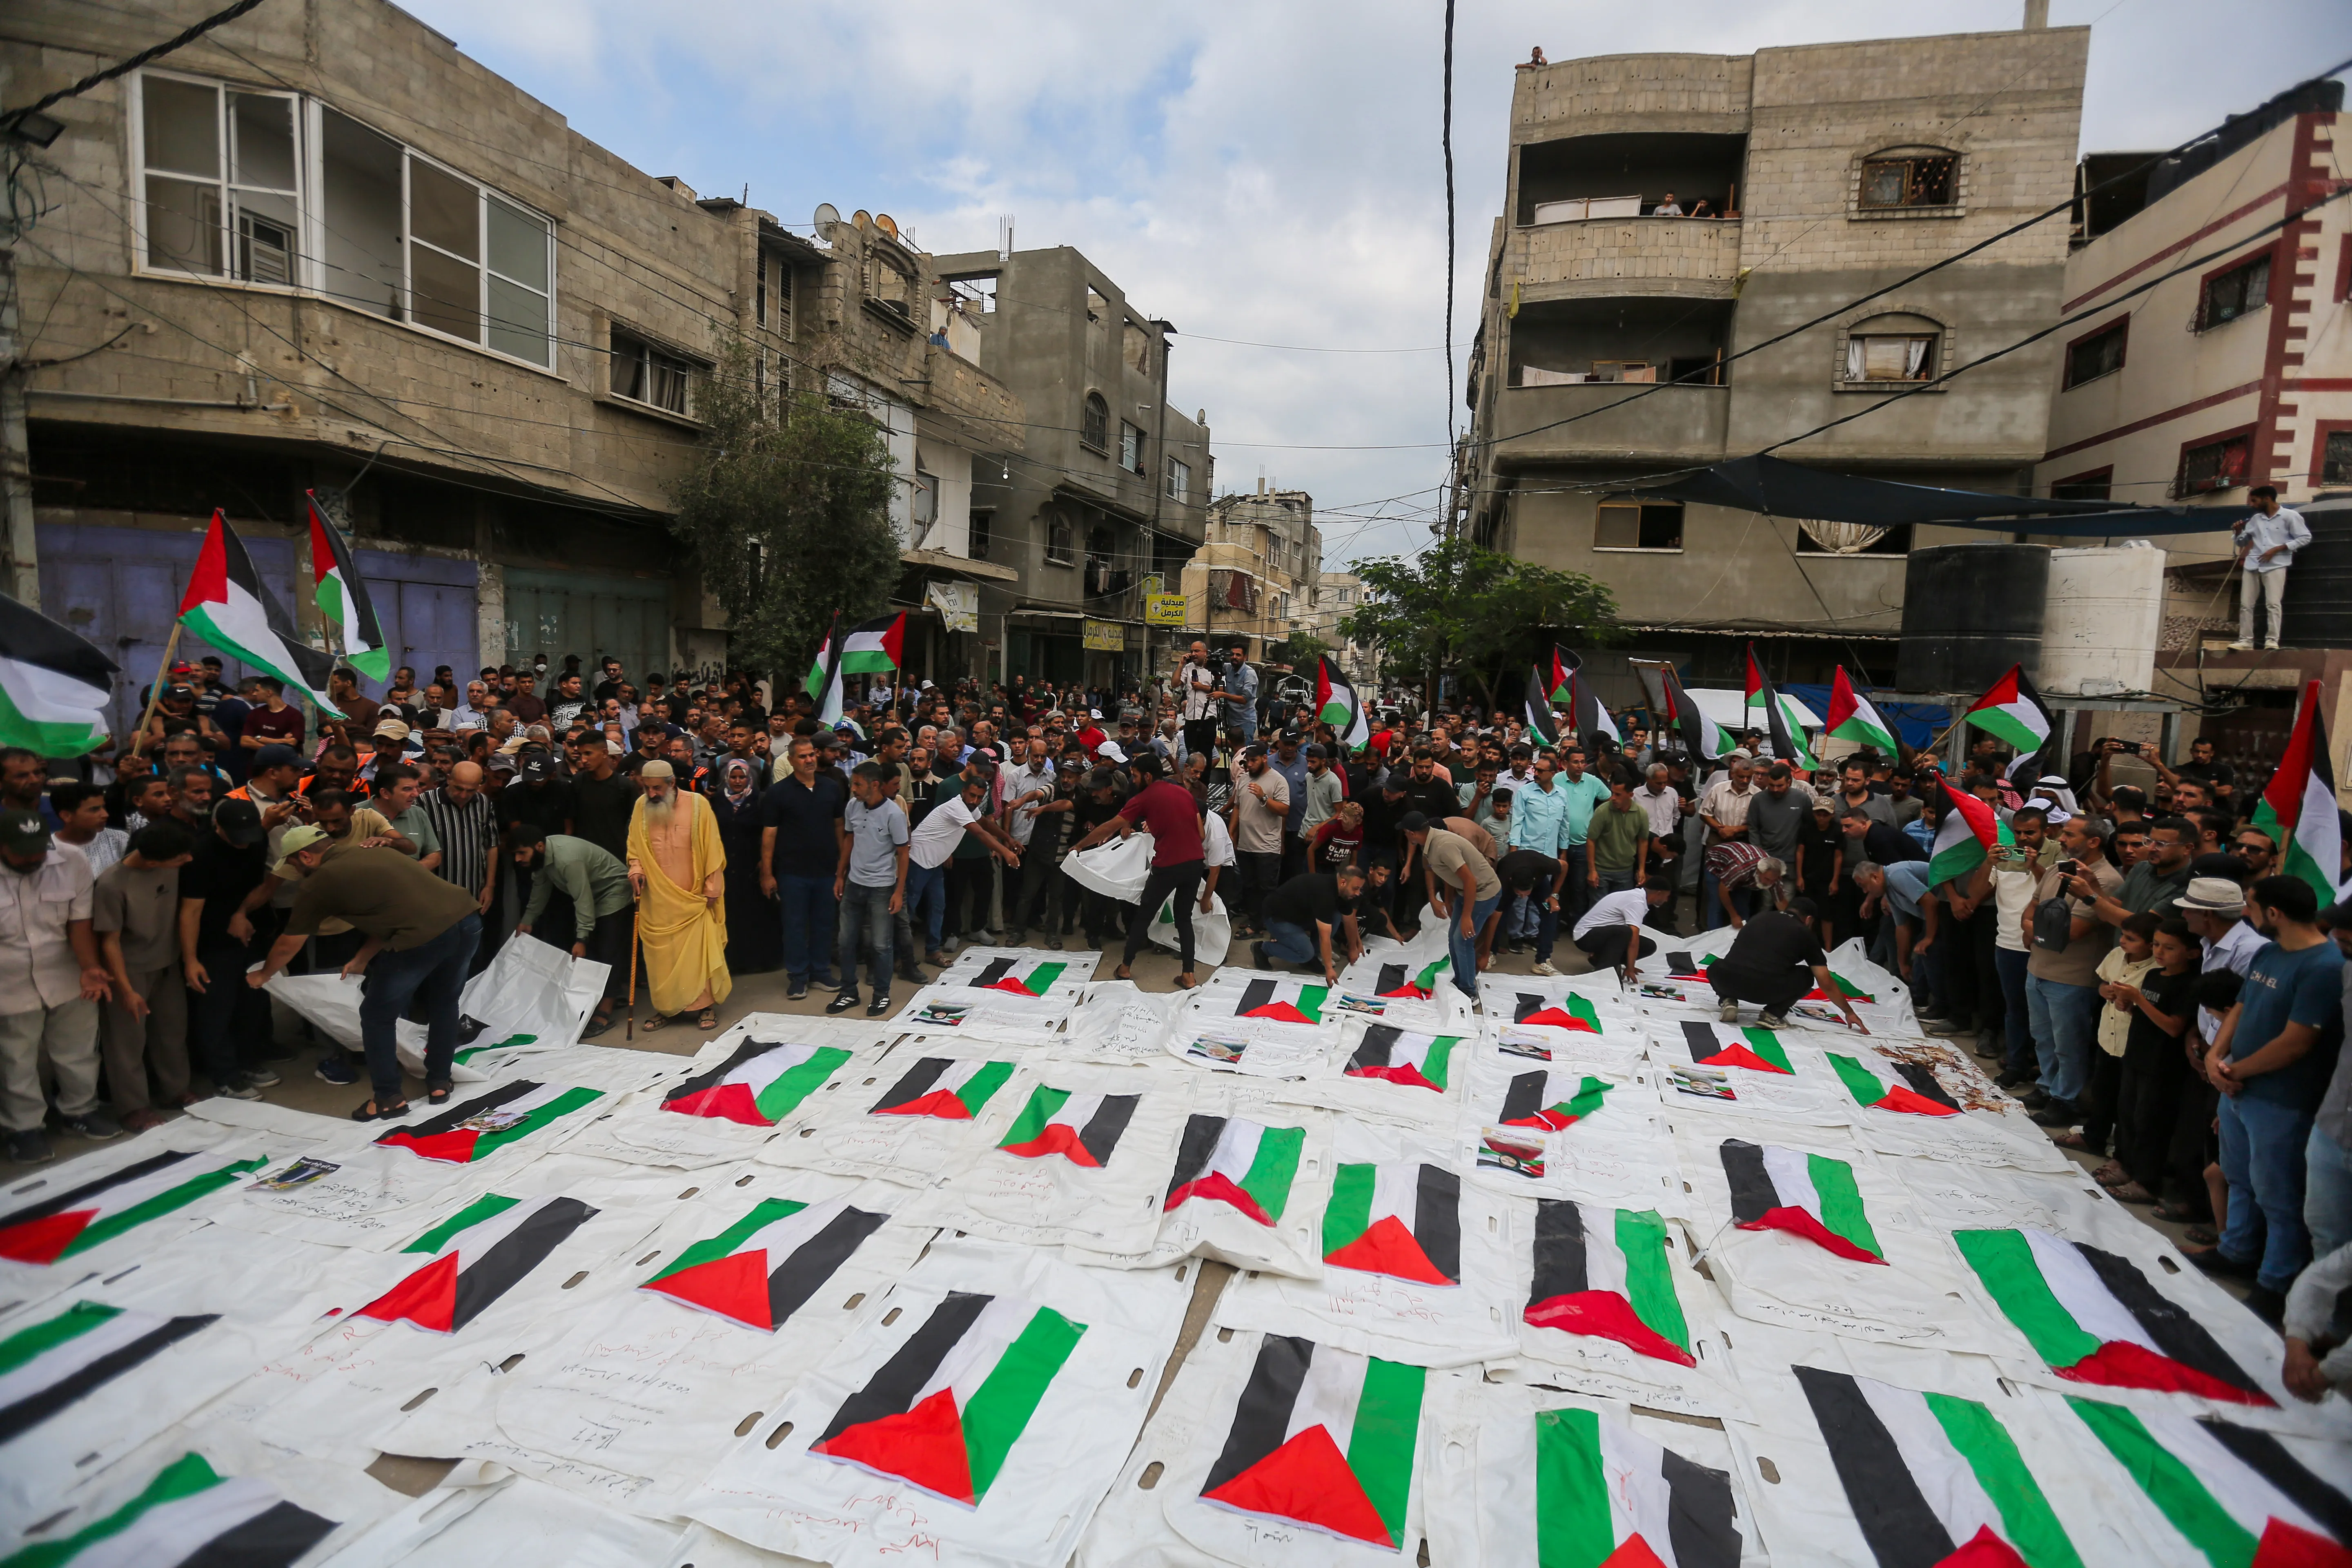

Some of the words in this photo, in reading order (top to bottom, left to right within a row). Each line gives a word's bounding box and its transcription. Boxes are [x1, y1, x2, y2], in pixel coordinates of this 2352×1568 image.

[1161, 598, 1184, 608] صيدلية
[1161, 609, 1183, 618] الكرمل
[2250, 970, 2277, 989] CHAEL
